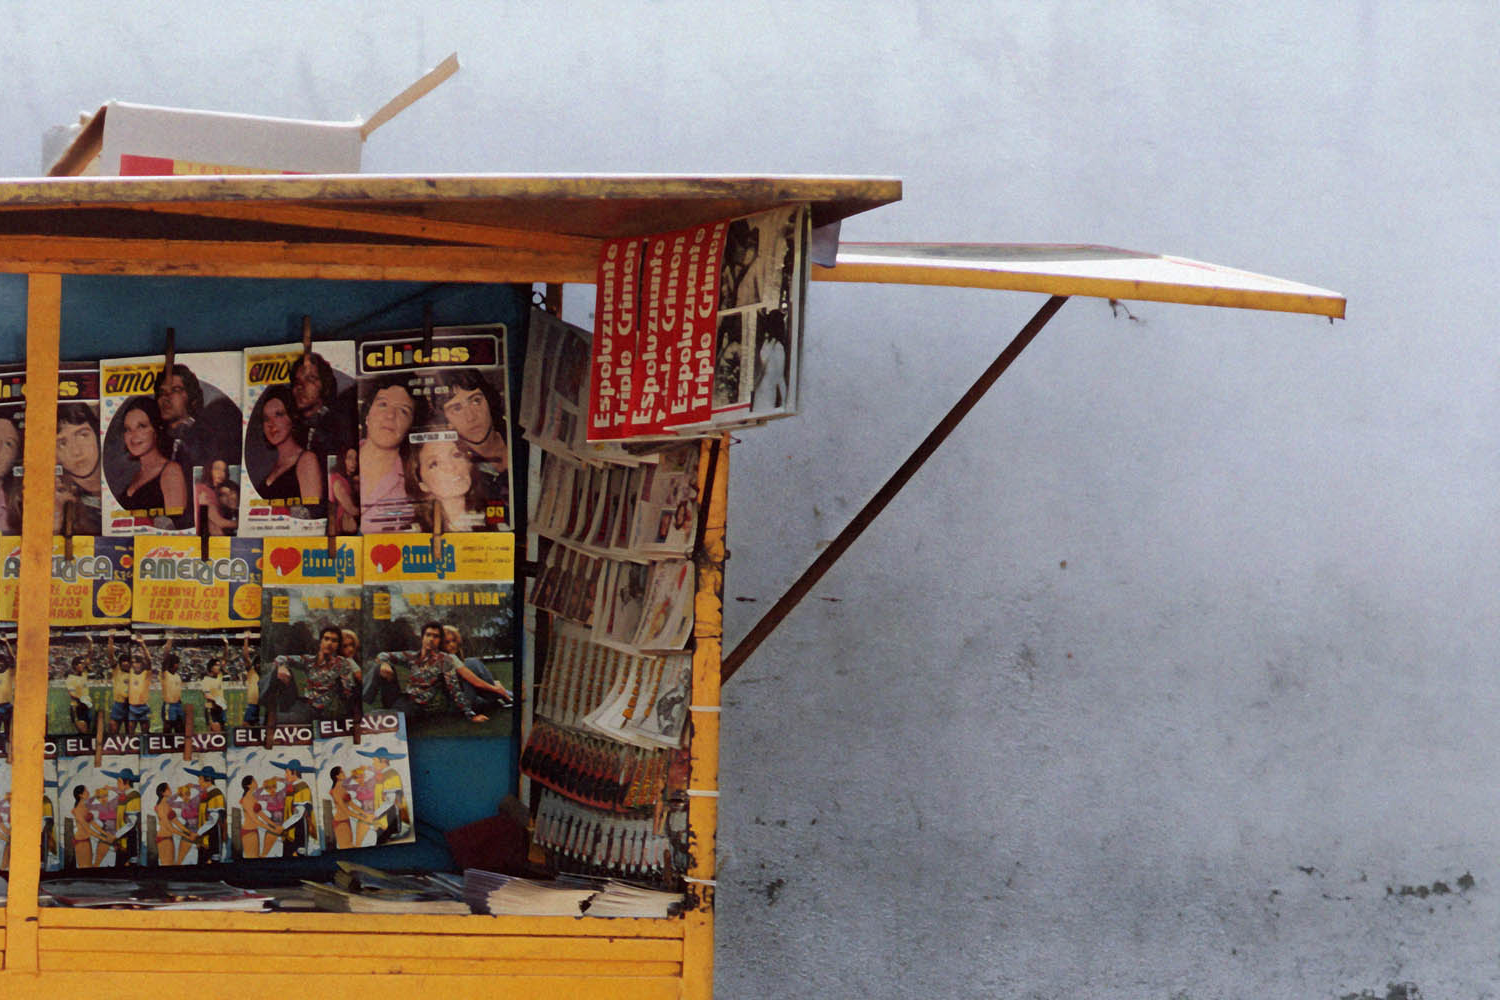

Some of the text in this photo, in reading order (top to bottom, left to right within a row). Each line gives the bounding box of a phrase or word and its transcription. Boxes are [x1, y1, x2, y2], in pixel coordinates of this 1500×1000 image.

[366, 344, 470, 368] chicas
[320, 720, 343, 734] EL
[149, 736, 172, 750] EL
[235, 729, 258, 743] EL
[66, 738, 89, 752] EL
[91, 735, 140, 752] AYO
